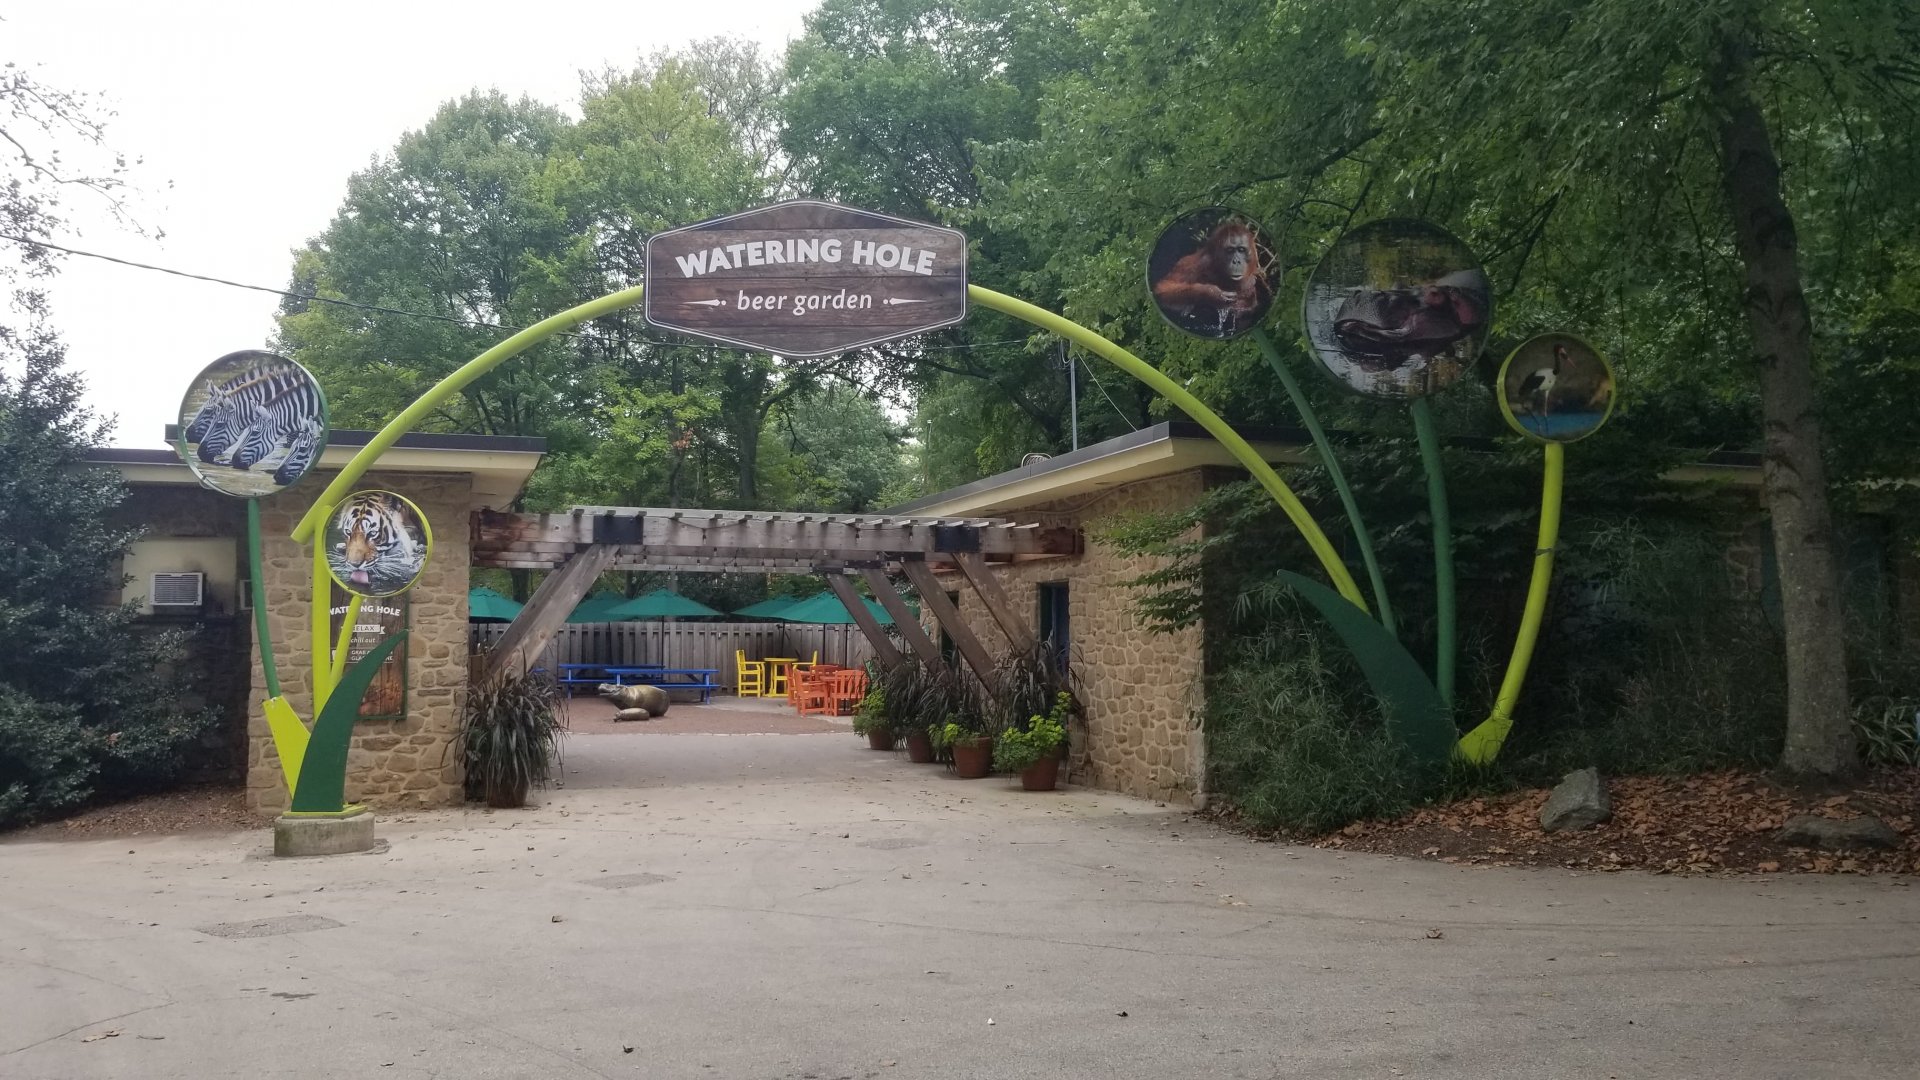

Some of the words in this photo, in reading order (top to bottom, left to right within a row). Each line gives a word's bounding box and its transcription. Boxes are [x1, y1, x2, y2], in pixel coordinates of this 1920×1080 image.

[675, 239, 842, 278] WATERING
[852, 240, 936, 276] HOLE
[738, 290, 787, 310] beer
[793, 289, 872, 315] garden
[377, 605, 400, 616] HOLE
